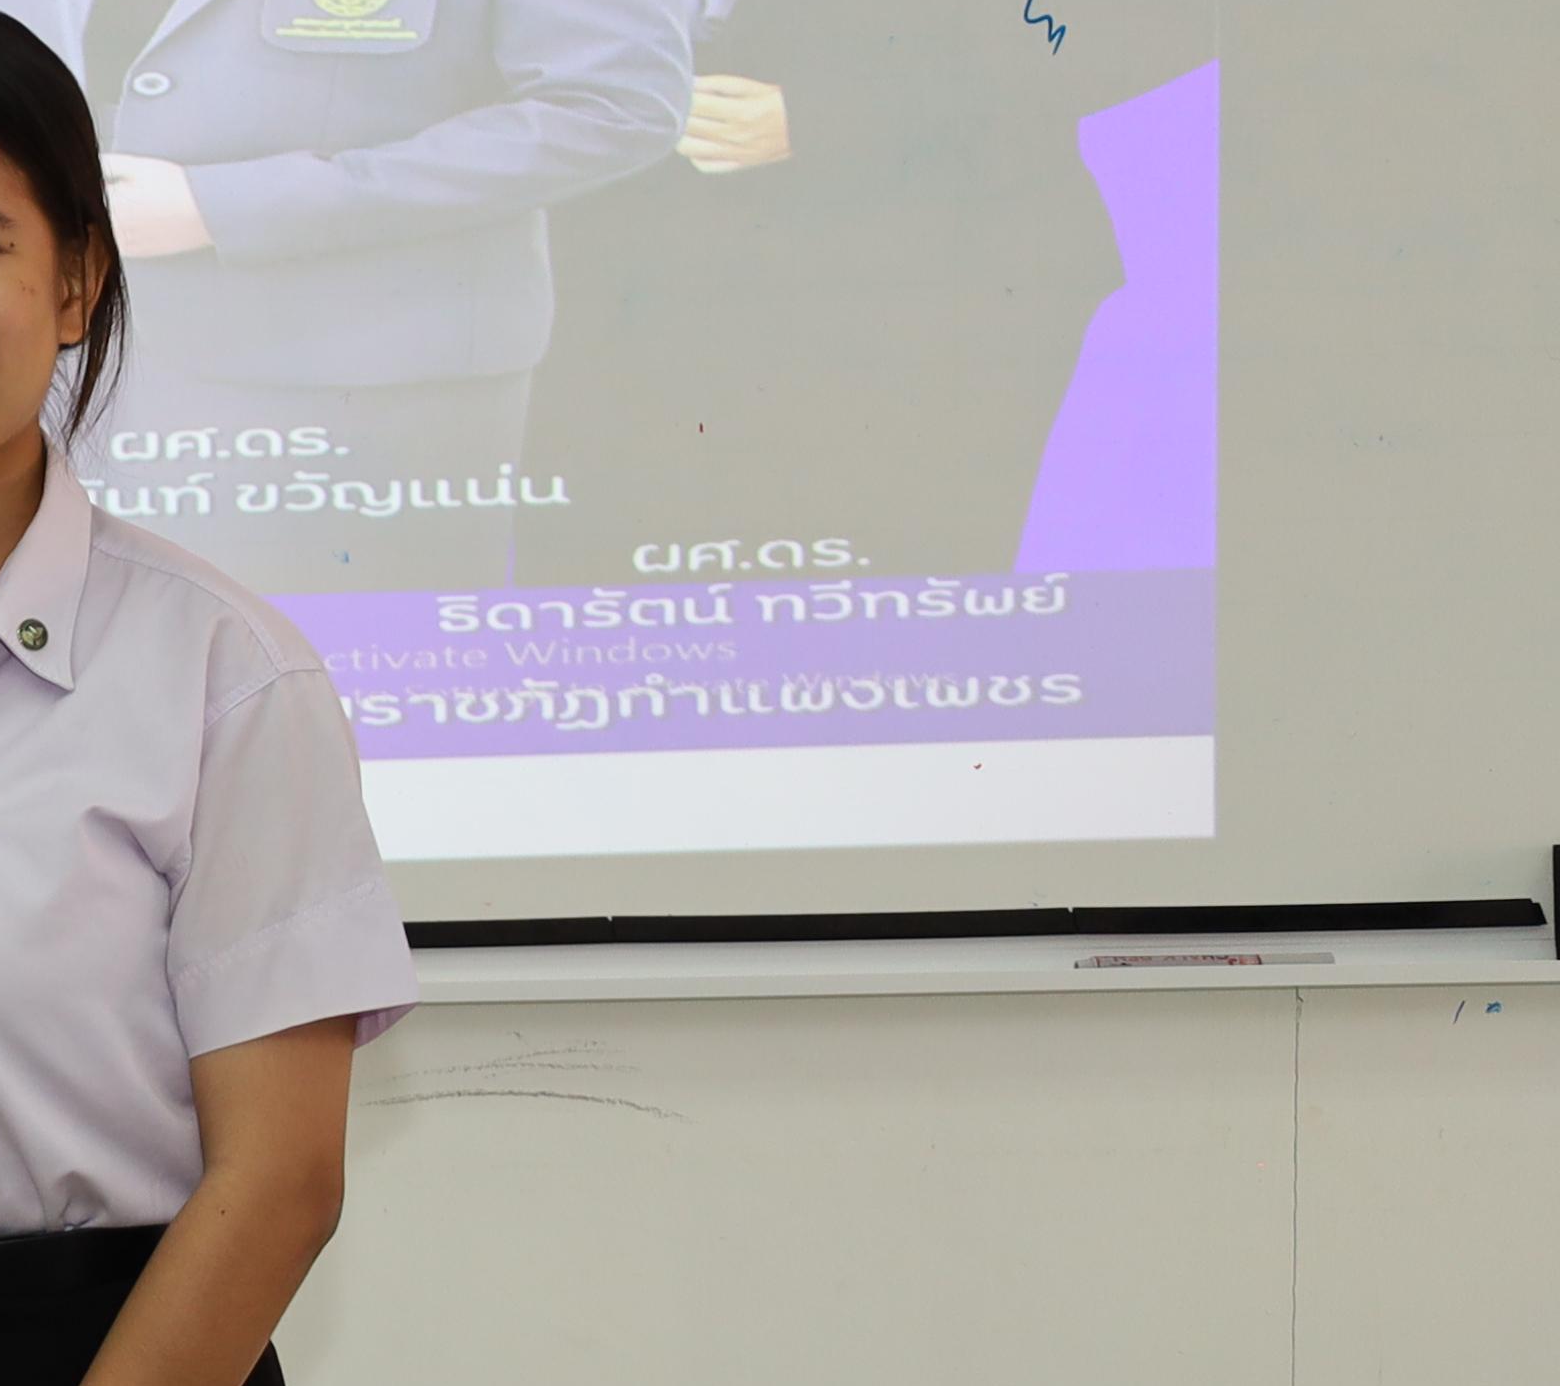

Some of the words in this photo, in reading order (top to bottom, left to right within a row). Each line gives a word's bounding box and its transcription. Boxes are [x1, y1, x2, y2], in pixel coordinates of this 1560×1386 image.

[110, 423, 351, 463] ผศ.ดร.
[234, 463, 572, 518] ขวัญแน่น
[632, 536, 871, 575] ผศ.ดร.
[435, 581, 734, 635] ธิดารัตน์
[754, 571, 1071, 626] ทวีทรัพย์
[322, 639, 489, 671] ctivate
[506, 633, 740, 668] Windows
[338, 670, 1085, 732] ราชภัฏกำแพงเพชร
